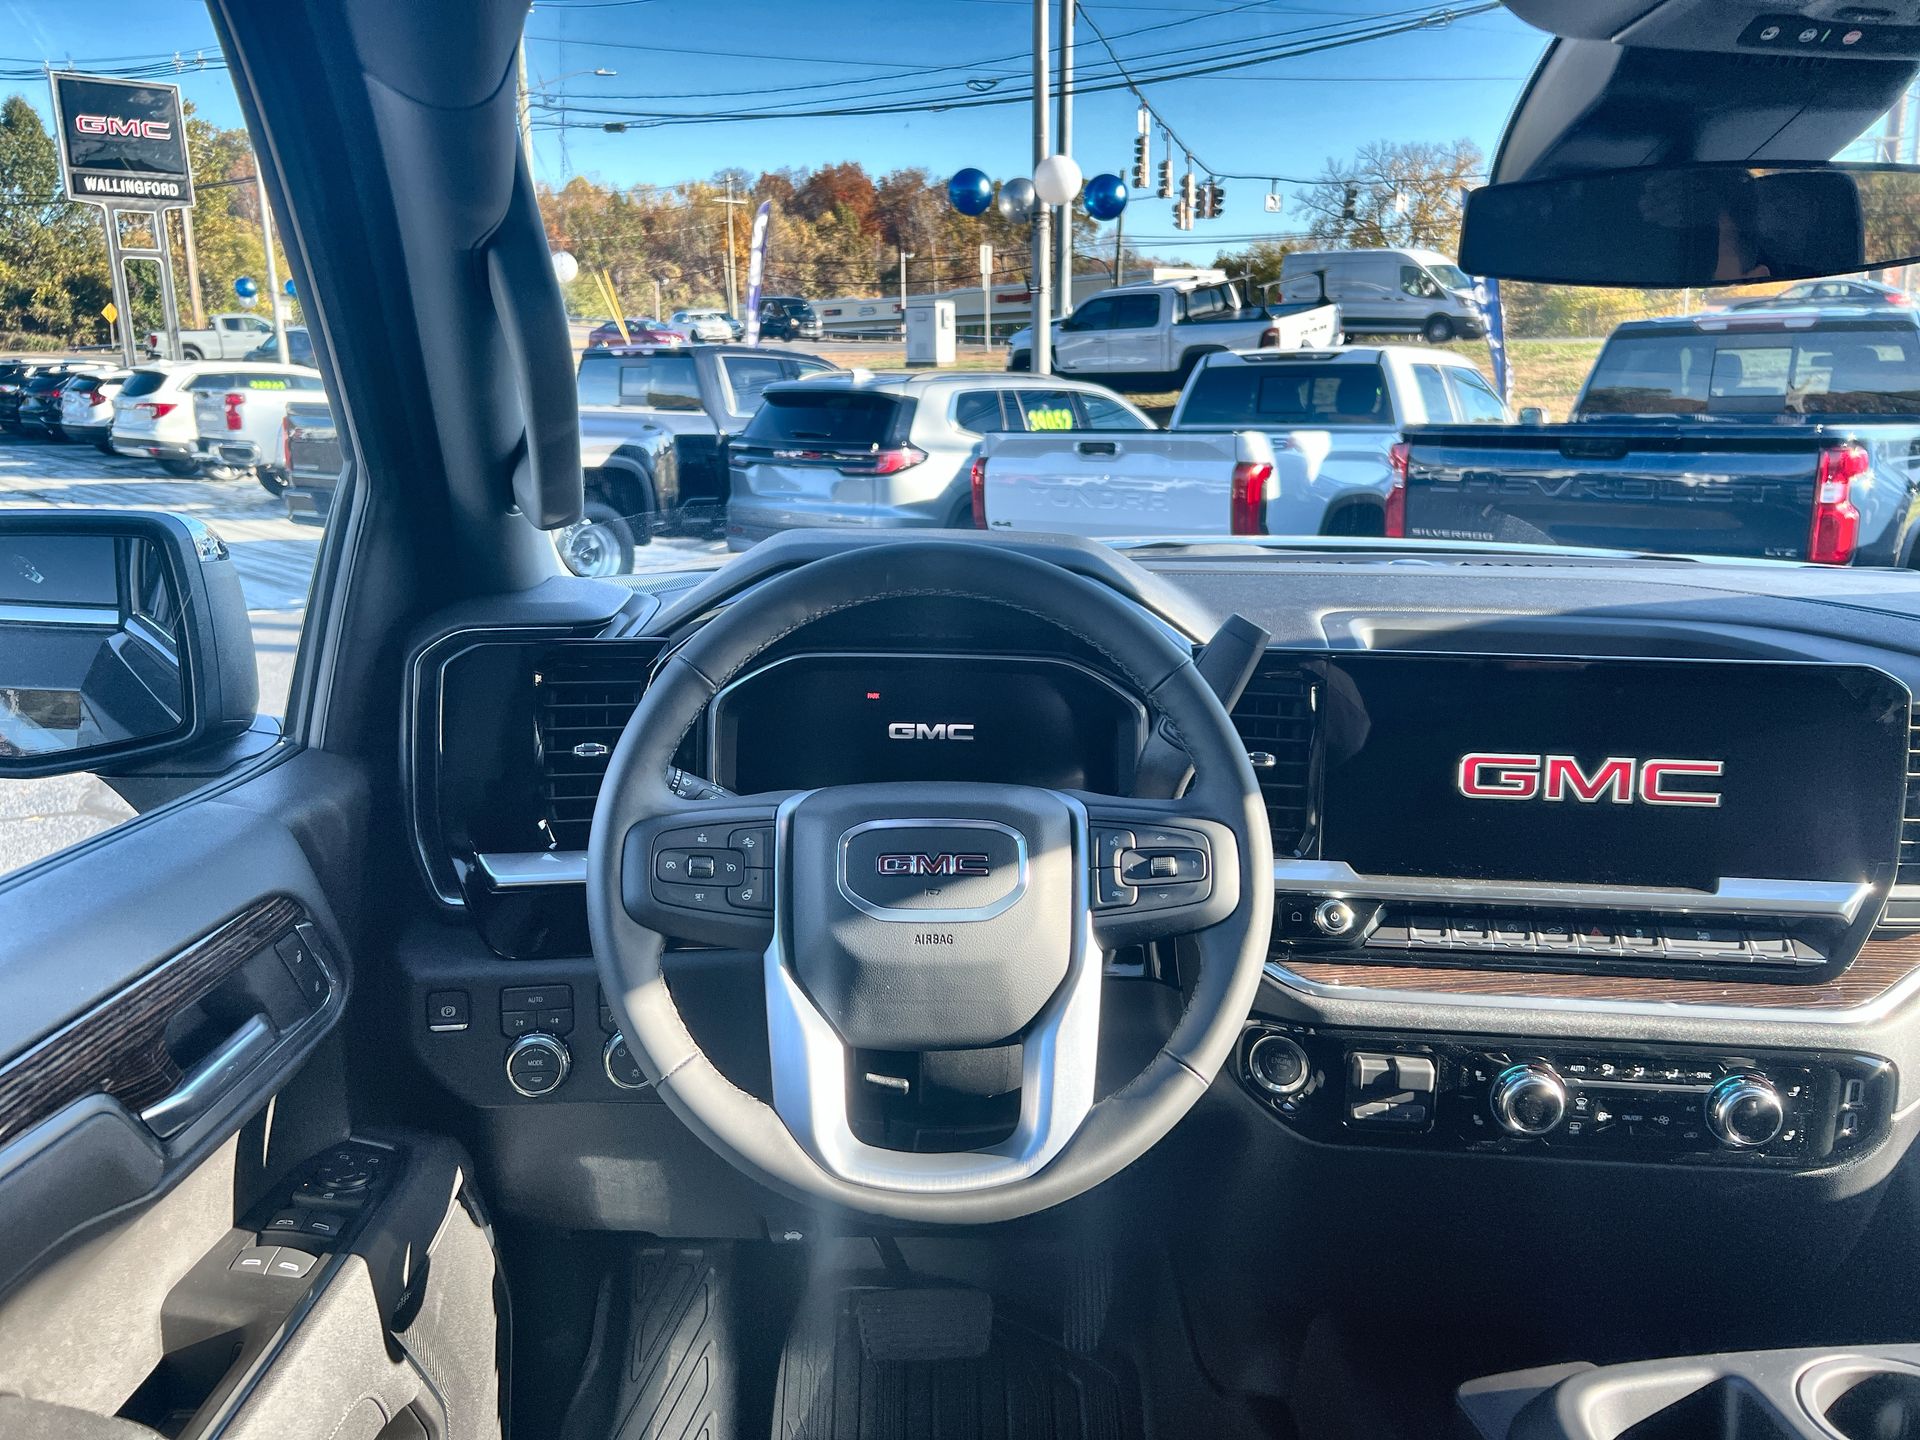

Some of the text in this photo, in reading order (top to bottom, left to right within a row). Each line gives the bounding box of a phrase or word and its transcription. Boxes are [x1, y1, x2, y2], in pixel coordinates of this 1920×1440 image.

[75, 114, 171, 140] GMC
[83, 176, 179, 197] WALLINGFORD
[1411, 527, 1494, 541] SILVERADO
[888, 723, 975, 740] GMC
[1458, 752, 1724, 808] GMC
[876, 853, 990, 876] GMC
[914, 933, 954, 945] AIRBAG
[527, 995, 543, 1003] AUTO
[527, 1058, 544, 1067] MODE
[1570, 1064, 1586, 1072] AUTO
